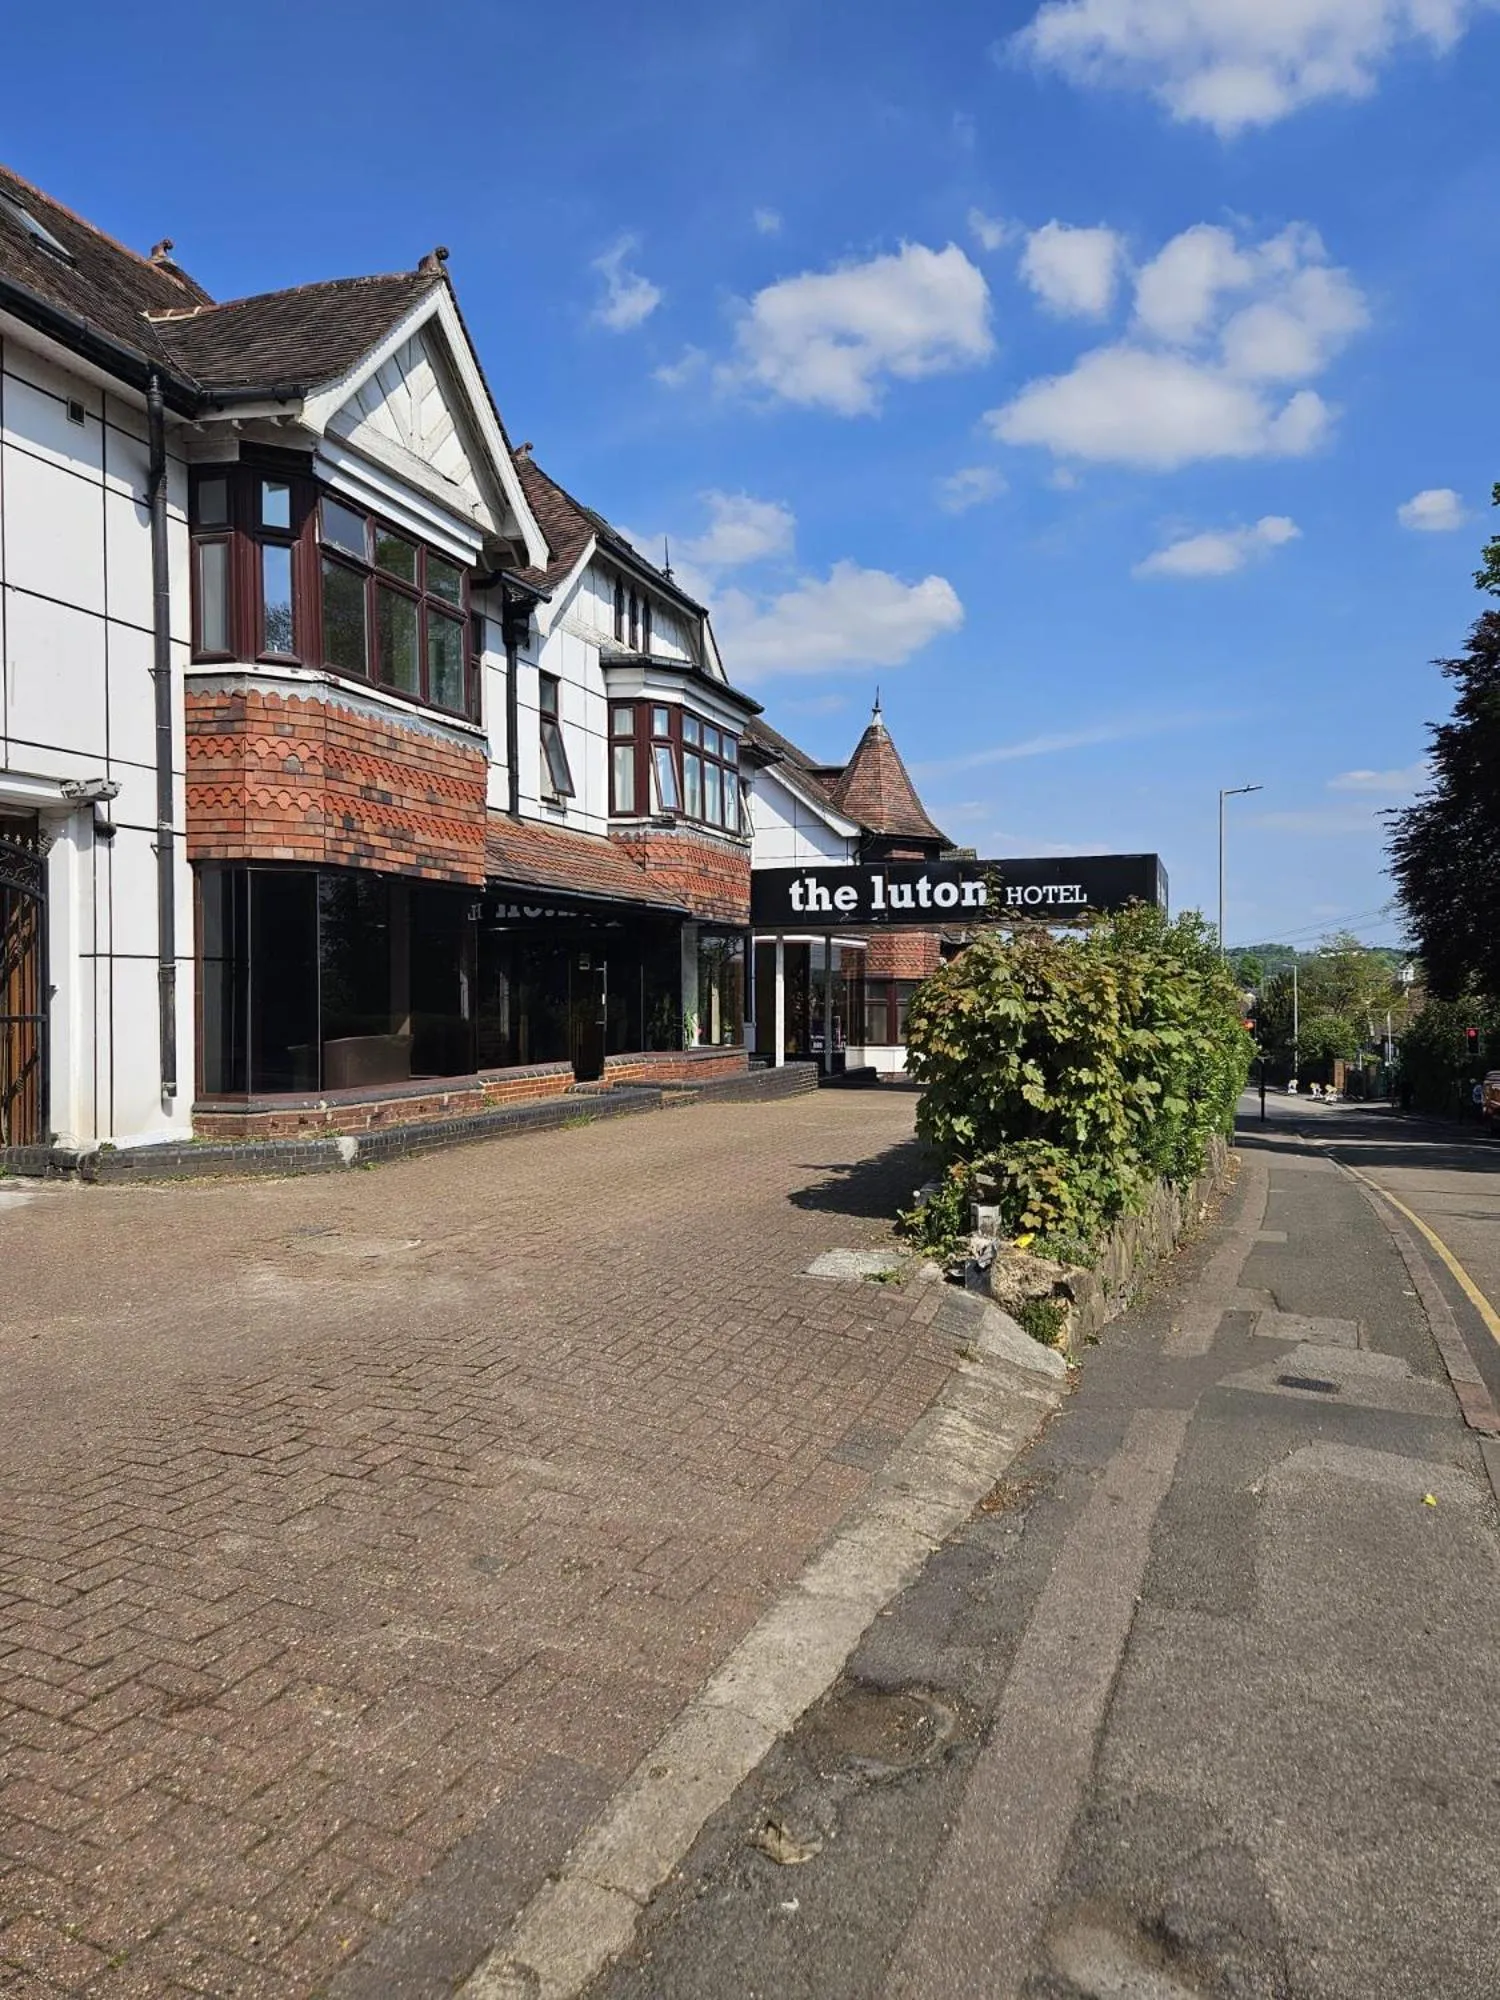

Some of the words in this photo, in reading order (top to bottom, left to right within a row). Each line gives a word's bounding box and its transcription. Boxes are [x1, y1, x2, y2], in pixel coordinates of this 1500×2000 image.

[788, 877, 859, 911] the
[870, 874, 990, 910] luton
[1005, 884, 1088, 905] HOTEL
